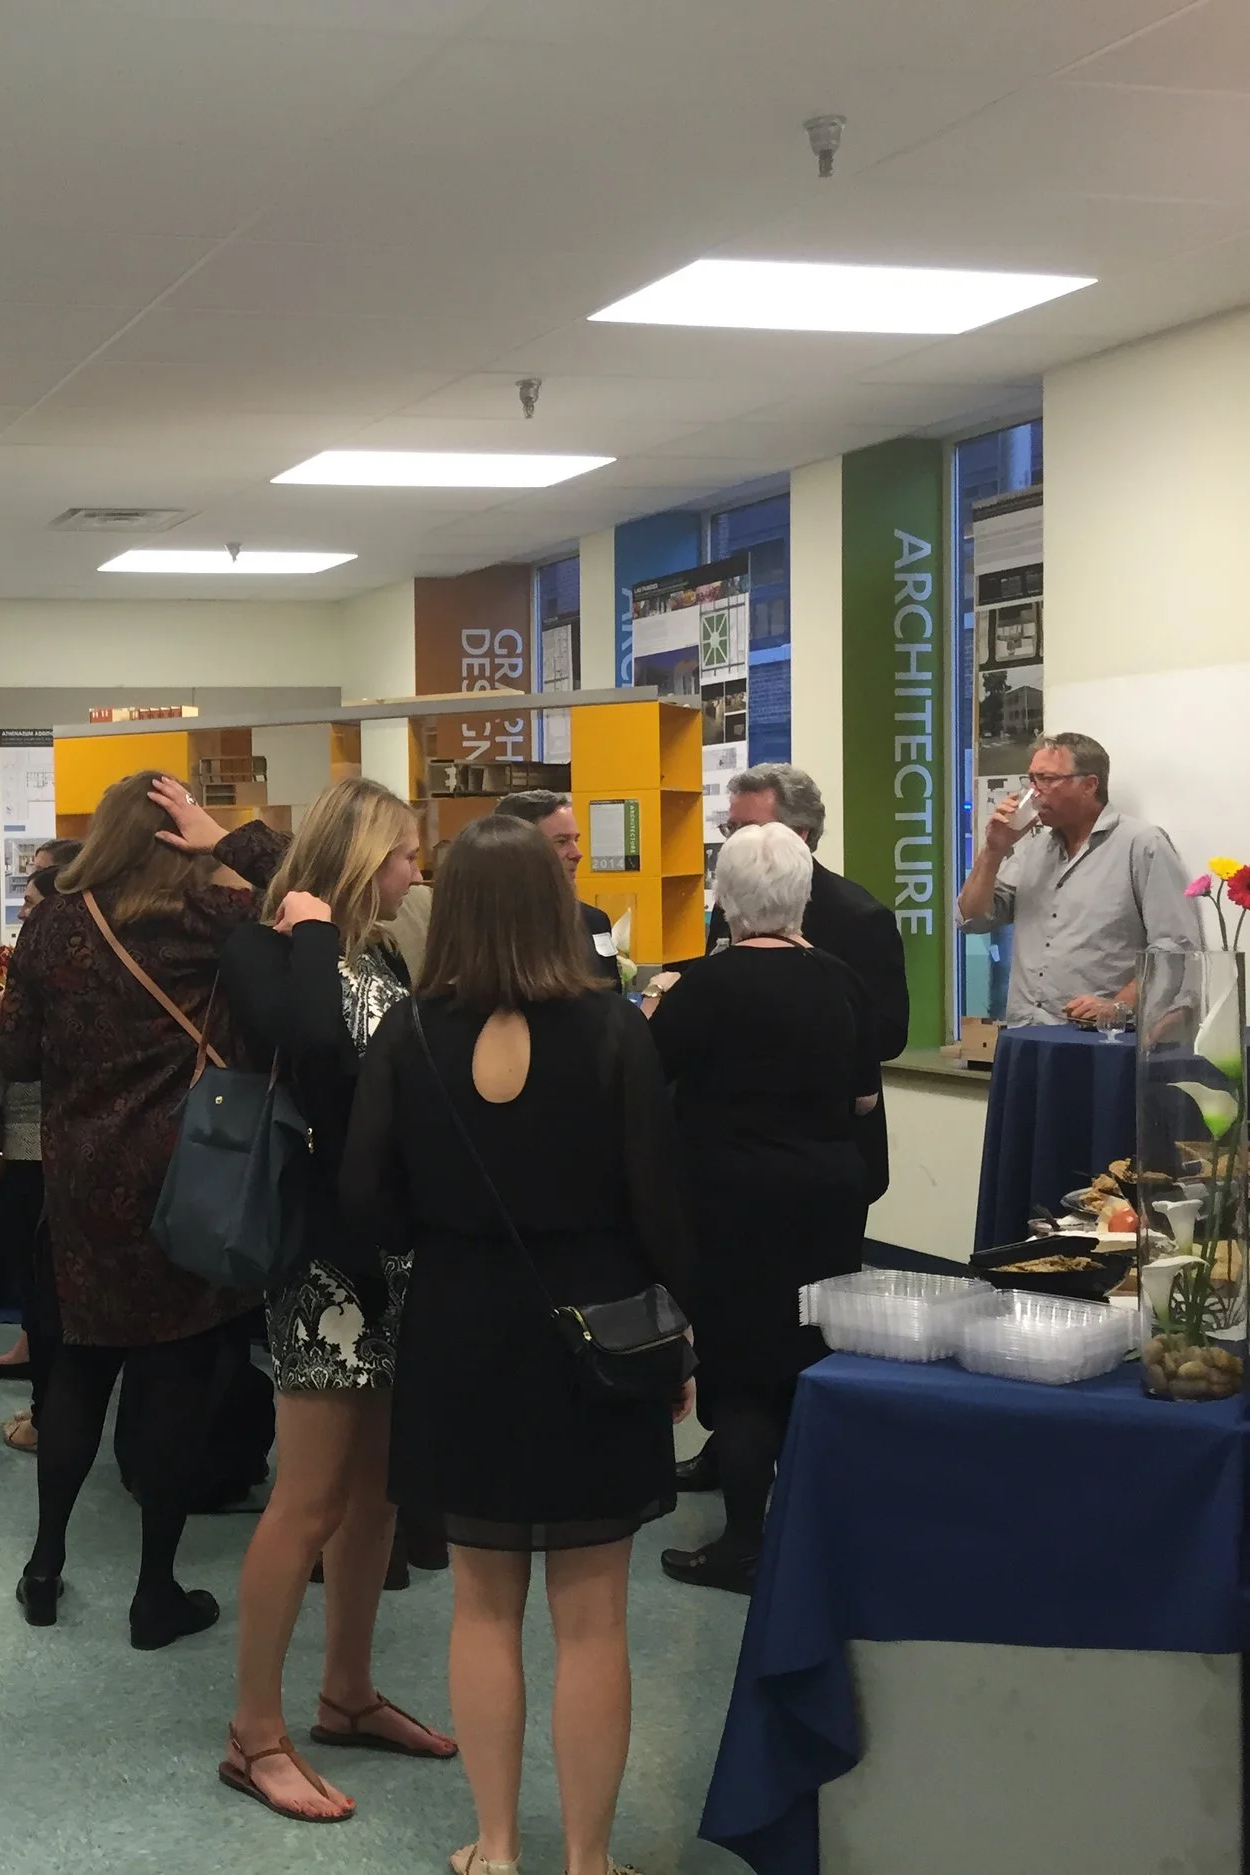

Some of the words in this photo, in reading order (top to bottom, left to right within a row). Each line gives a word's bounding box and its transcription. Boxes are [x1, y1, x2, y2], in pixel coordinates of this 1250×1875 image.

[494, 628, 524, 761] GRH
[894, 528, 933, 935] ARCHITECTURE
[592, 859, 625, 870] 2014
